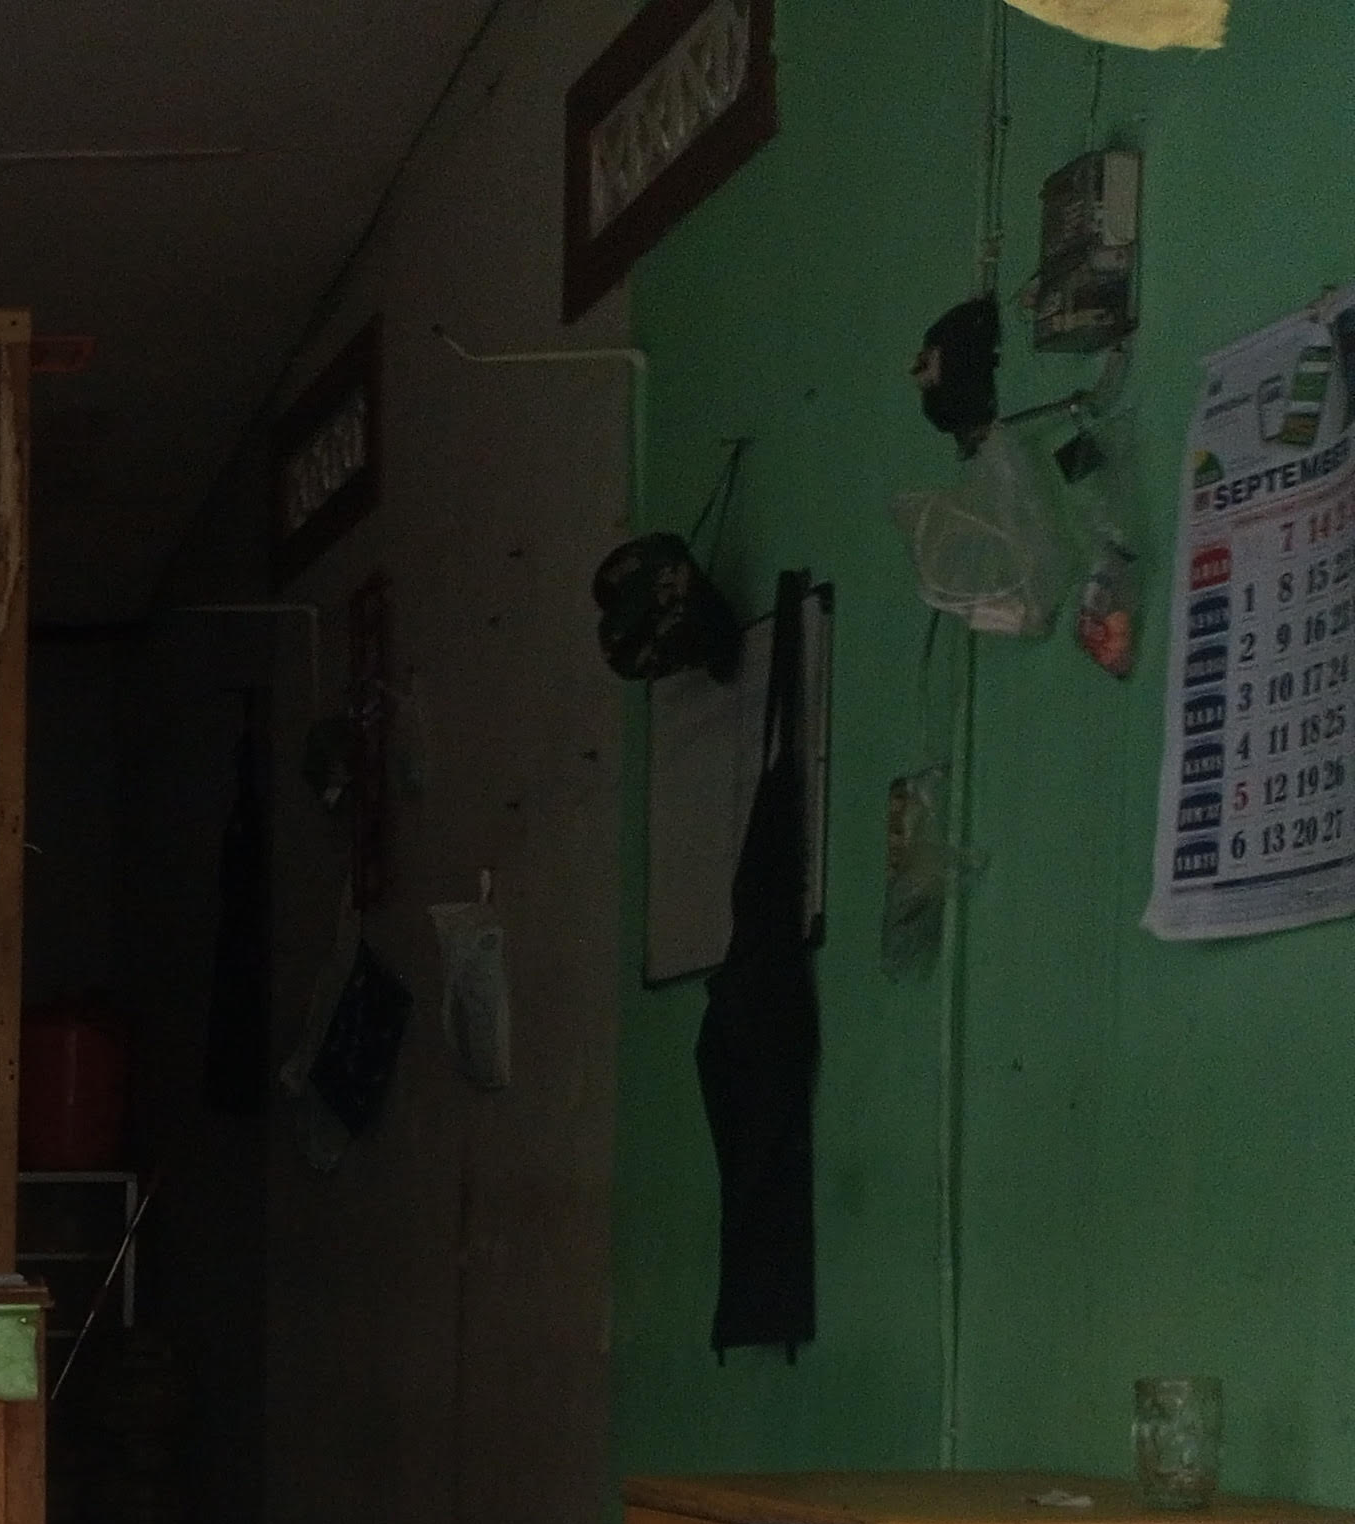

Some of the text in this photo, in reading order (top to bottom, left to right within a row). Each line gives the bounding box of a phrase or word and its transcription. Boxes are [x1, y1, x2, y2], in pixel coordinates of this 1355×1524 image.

[1281, 522, 1293, 551] 7
[1244, 584, 1255, 612] 1
[1278, 572, 1293, 603] 8
[1307, 560, 1329, 594] 15
[1239, 633, 1256, 662] 2
[1277, 624, 1292, 653] 9
[1304, 609, 1326, 645] 16
[1237, 682, 1252, 711] 3
[1269, 672, 1293, 705] 10
[1302, 662, 1323, 695] 17
[1236, 732, 1250, 760] 4
[1267, 722, 1289, 754] 11
[1300, 715, 1320, 747] 18
[1323, 705, 1346, 739] 25
[1234, 781, 1248, 811] 5
[1264, 773, 1287, 805] 12
[1297, 765, 1319, 798] 19
[1323, 757, 1345, 791] 26
[1232, 830, 1246, 859] 6
[1261, 823, 1285, 855] 13
[1293, 816, 1317, 849] 20
[1322, 809, 1345, 841] 27
